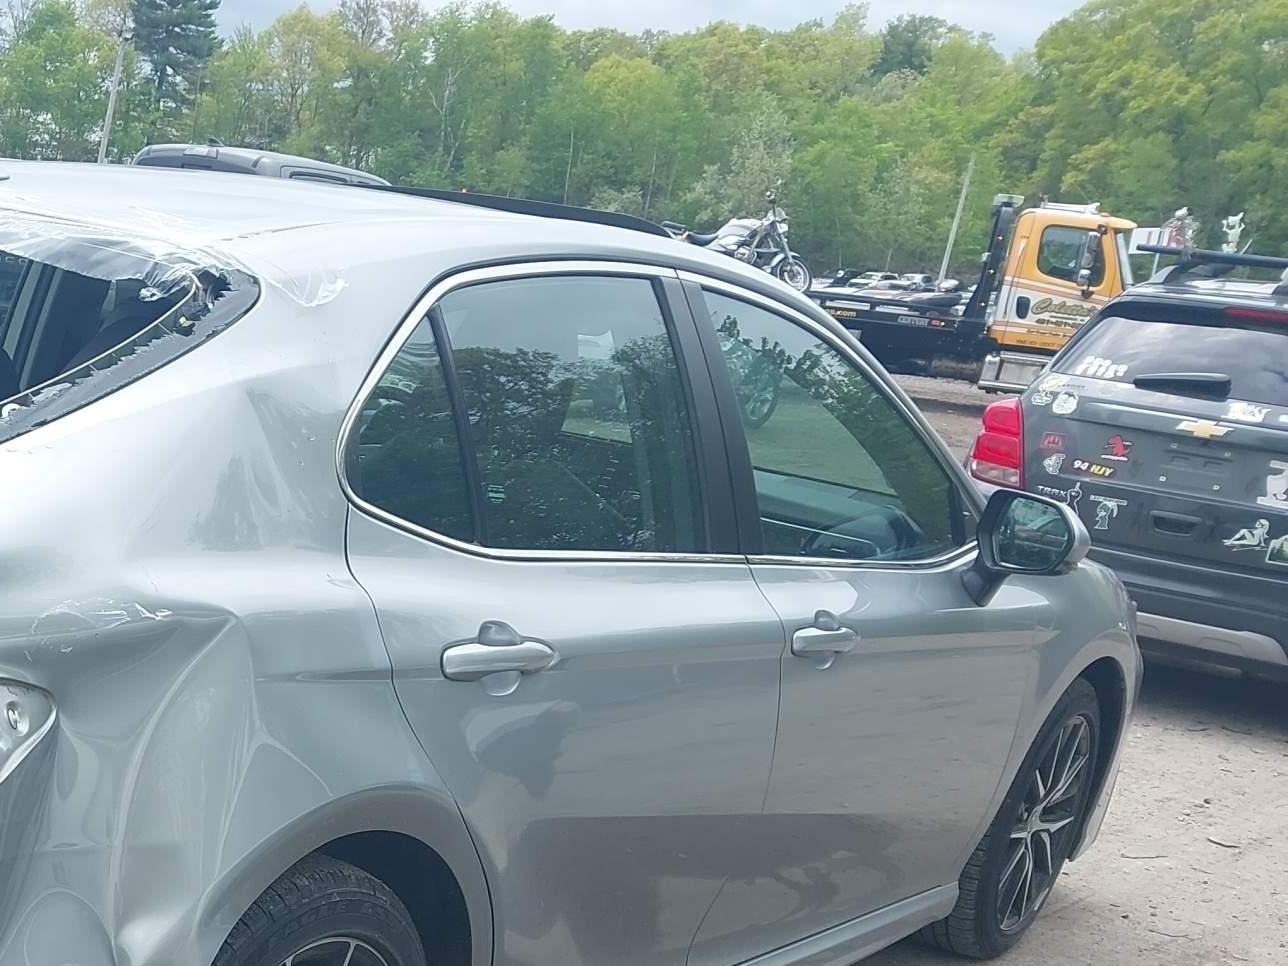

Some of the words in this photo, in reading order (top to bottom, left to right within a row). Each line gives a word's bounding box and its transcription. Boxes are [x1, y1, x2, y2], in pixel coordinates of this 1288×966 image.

[1073, 459, 1090, 471] 94
[1090, 464, 1114, 477] HJY
[1037, 485, 1067, 497] TRAX
